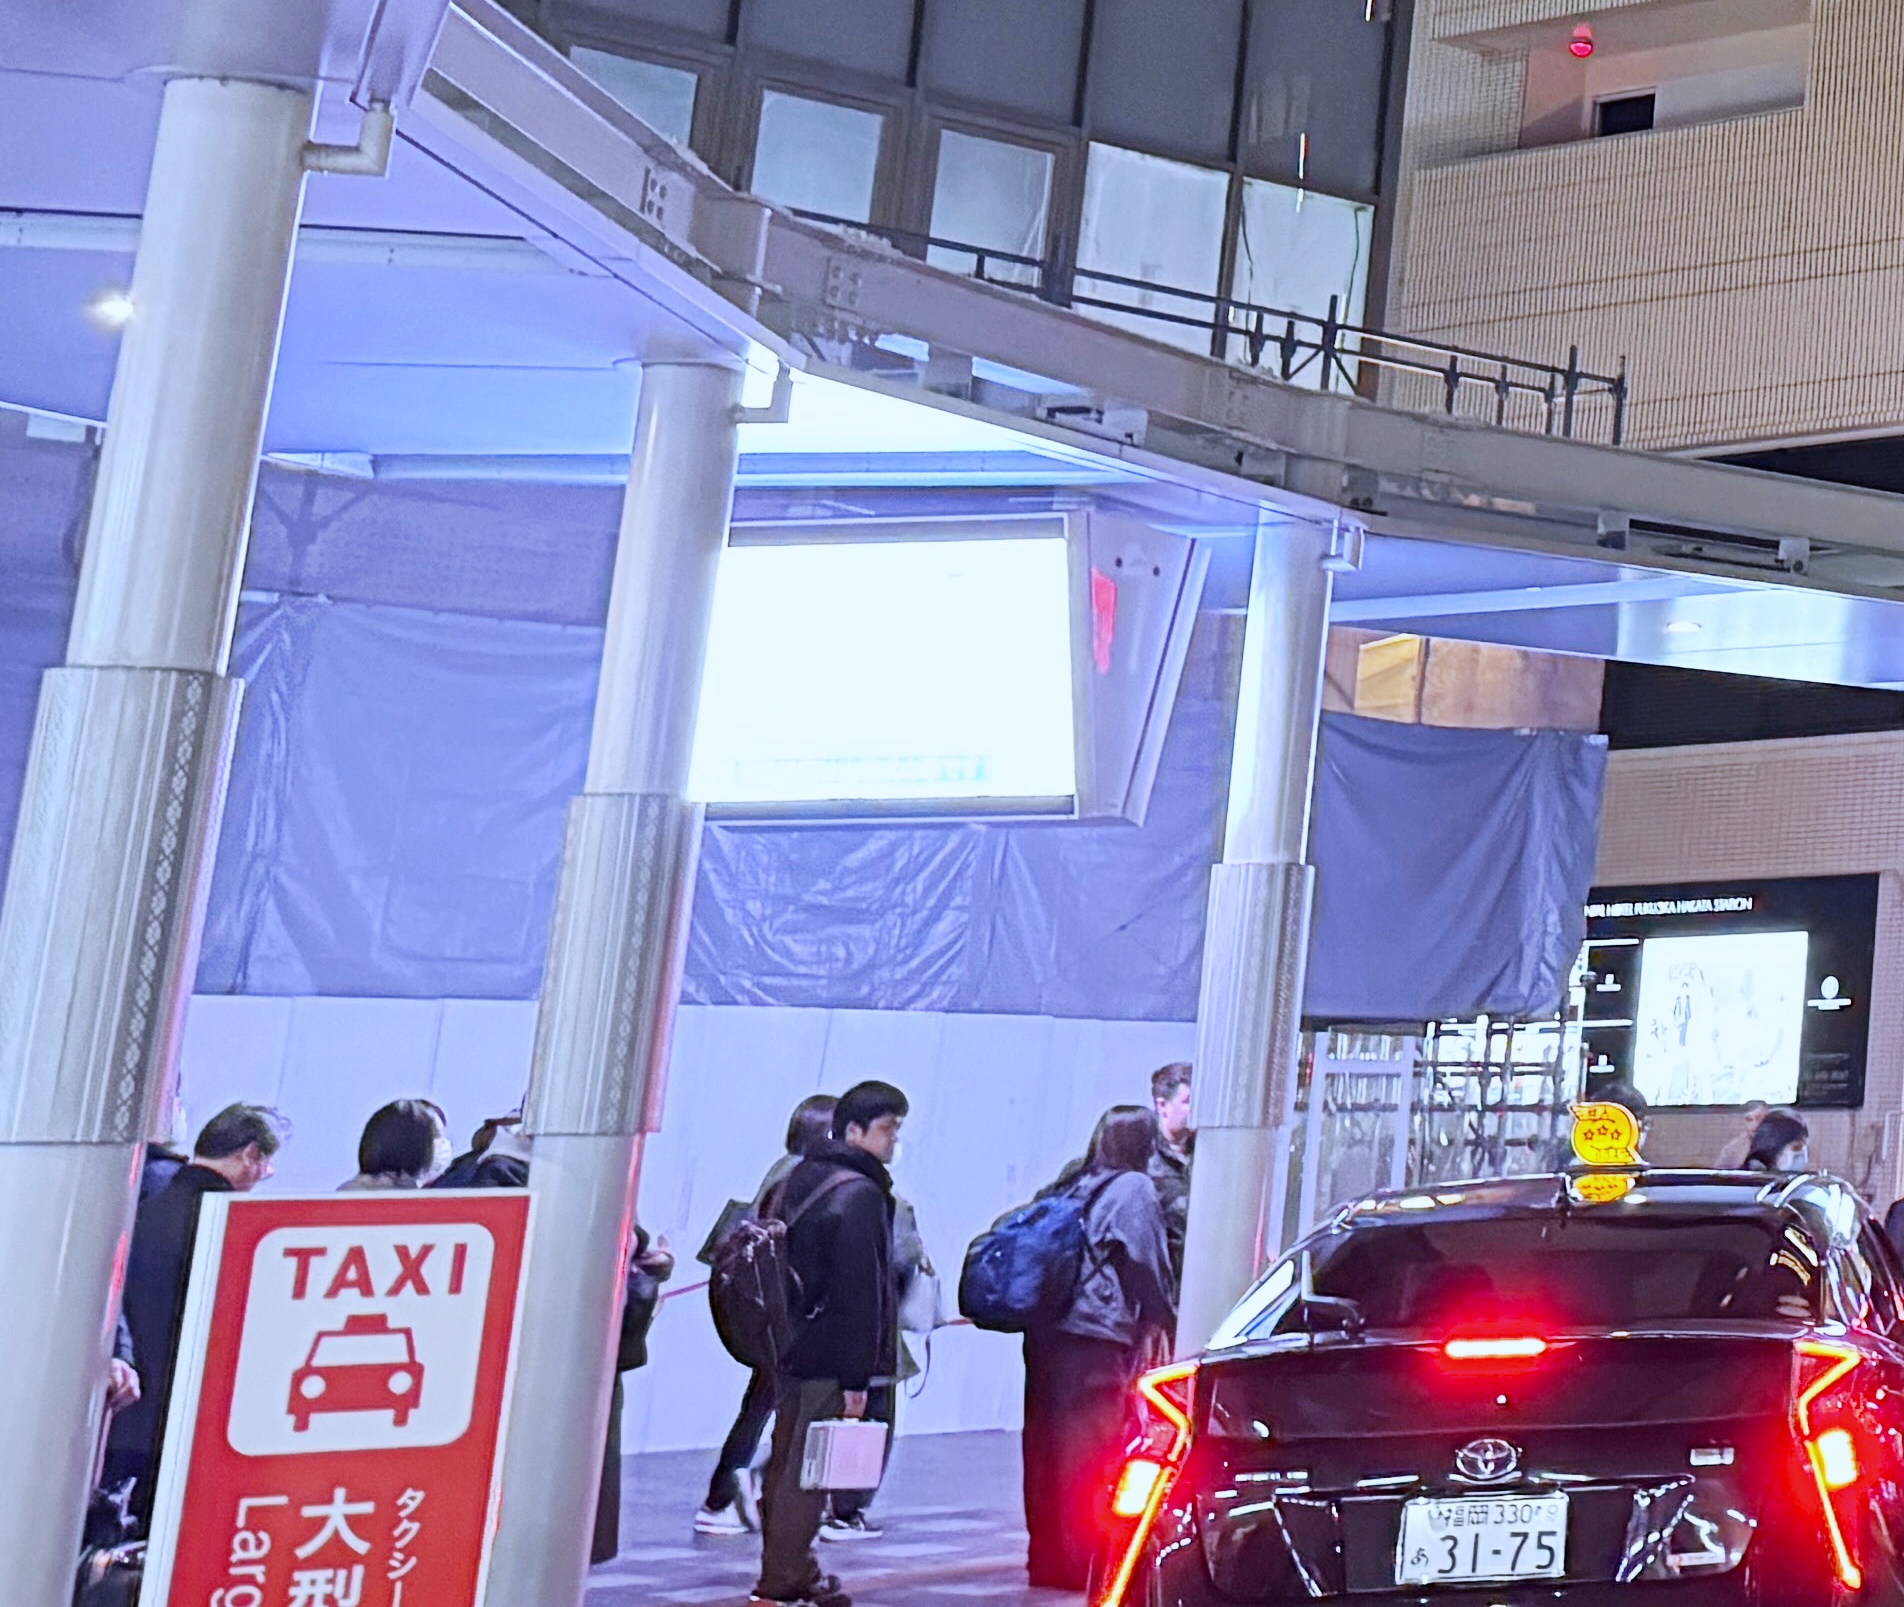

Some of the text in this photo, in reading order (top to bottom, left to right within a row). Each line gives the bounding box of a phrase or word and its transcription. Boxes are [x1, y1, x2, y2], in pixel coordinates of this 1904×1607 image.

[283, 1243, 468, 1300] TAXI
[1492, 1503, 1533, 1525] 330
[387, 1487, 425, 1607] タクシー
[1437, 1530, 1558, 1574] 31-75
